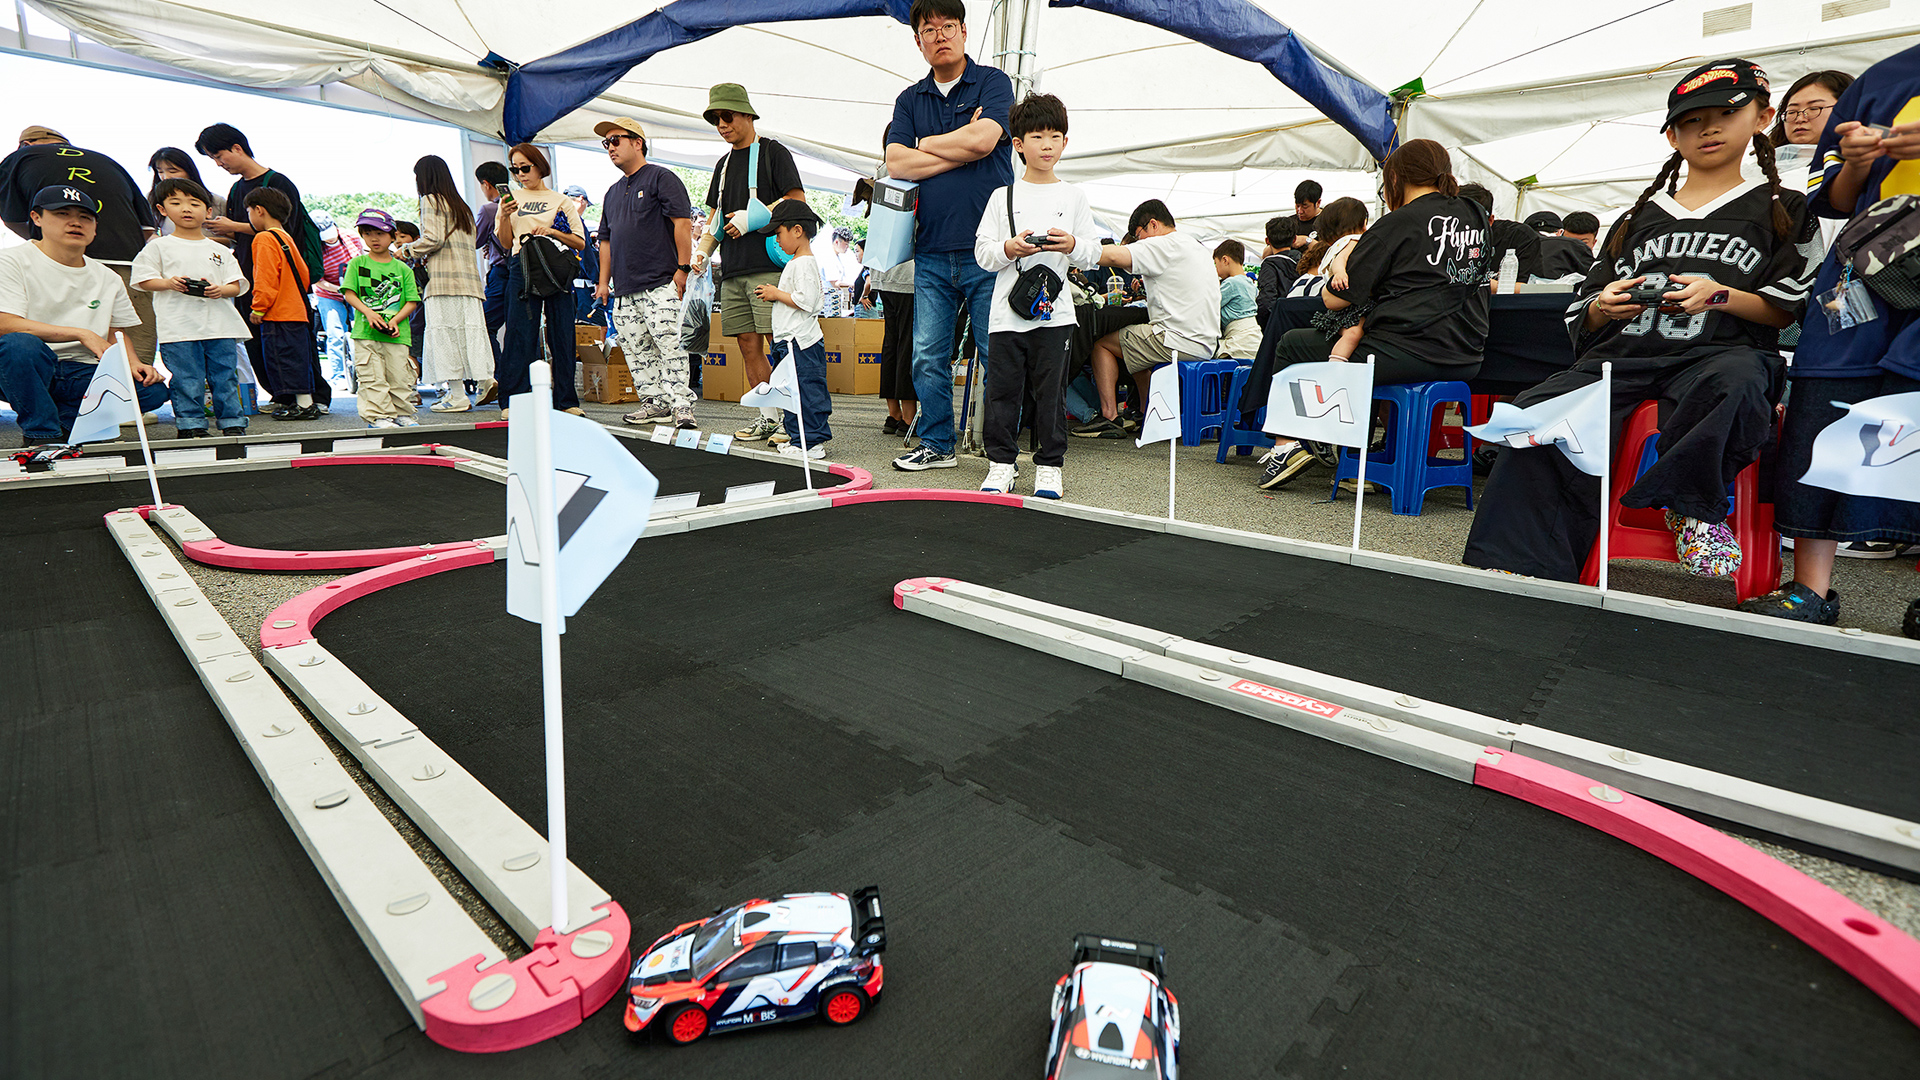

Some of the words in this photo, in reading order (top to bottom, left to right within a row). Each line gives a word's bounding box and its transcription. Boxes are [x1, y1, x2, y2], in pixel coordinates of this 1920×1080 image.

[63, 188, 81, 202] NY
[522, 202, 549, 211] NIKE
[1236, 682, 1335, 715] KYOSHO
[743, 1009, 777, 1025] MOBIS
